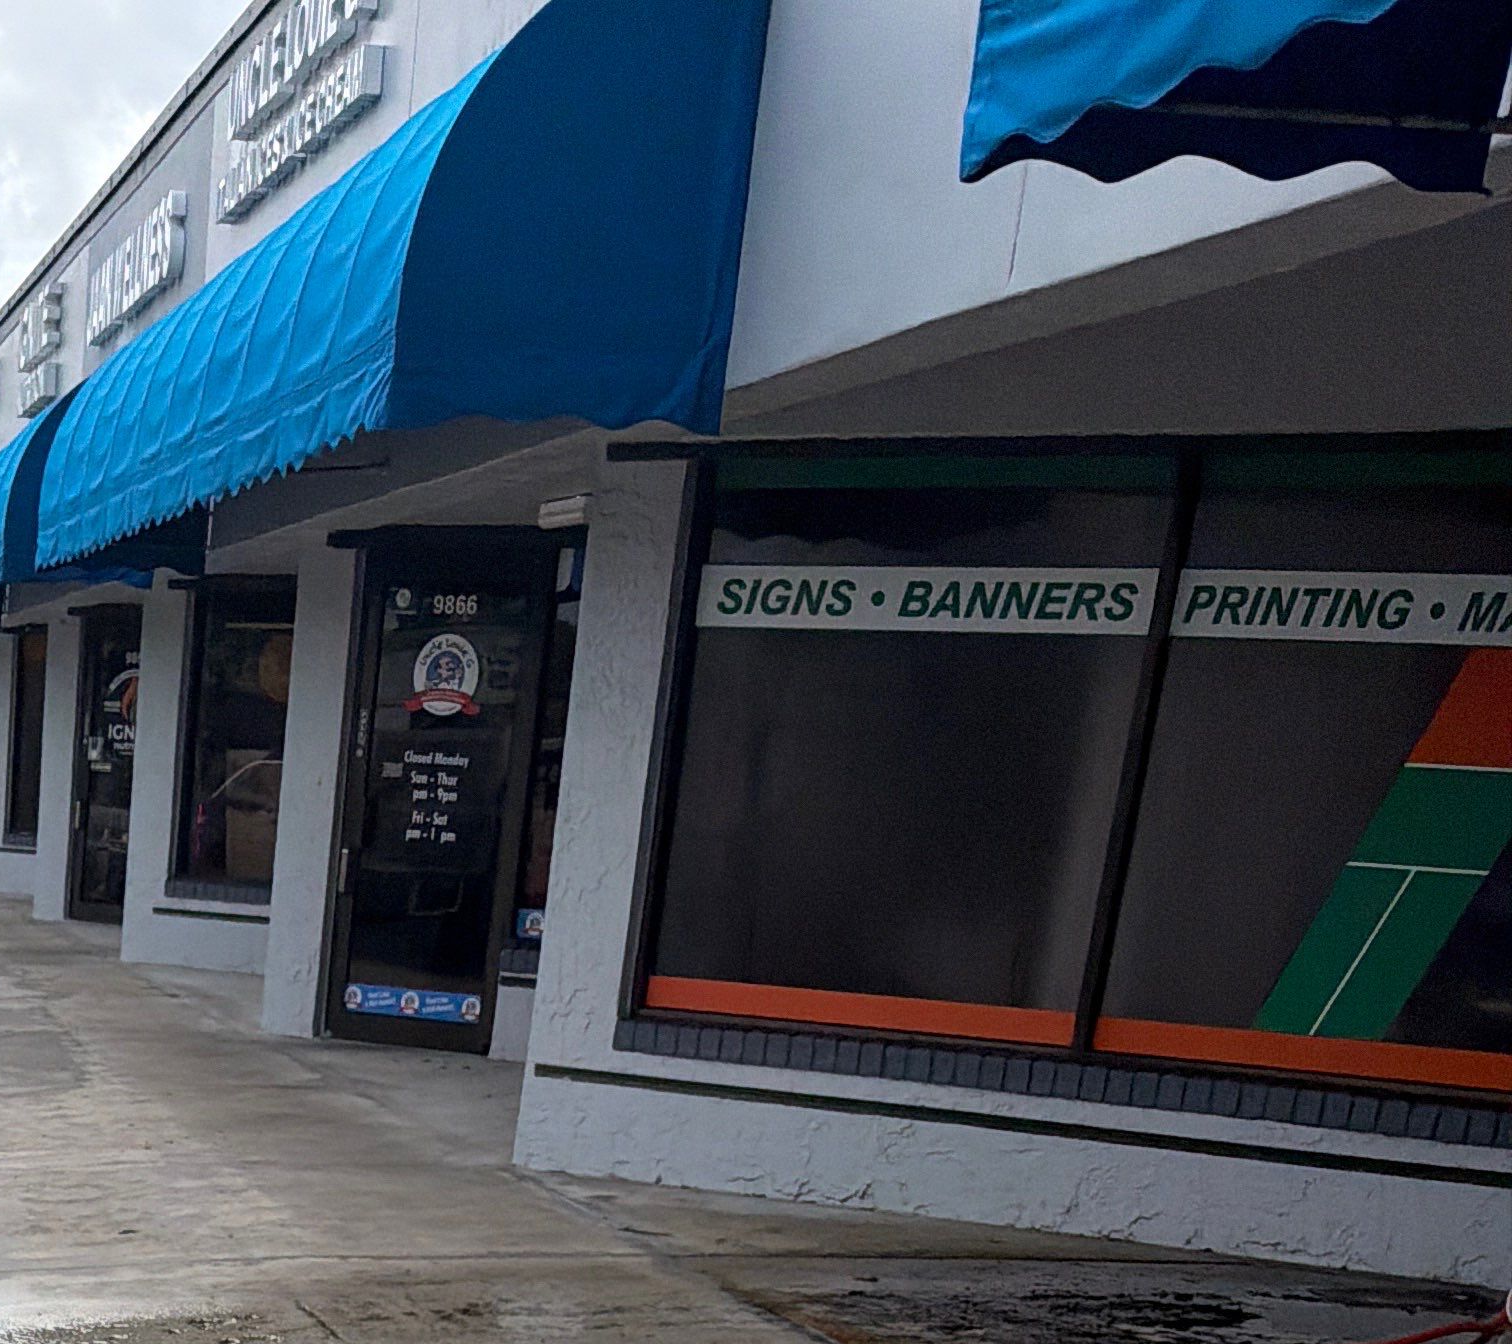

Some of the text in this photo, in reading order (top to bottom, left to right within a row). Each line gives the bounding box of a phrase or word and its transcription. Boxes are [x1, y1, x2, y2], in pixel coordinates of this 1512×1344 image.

[228, 20, 282, 141] UNCLE
[433, 594, 478, 615] 9866
[716, 579, 856, 616] SIGNS
[898, 581, 1138, 622] BANNERS
[1182, 585, 1414, 630] PRINTING
[404, 750, 469, 769] Closed Monday
[410, 770, 428, 784] Sun
[437, 772, 459, 786] Thur
[411, 810, 424, 824] Fri
[432, 812, 448, 826] Sat
